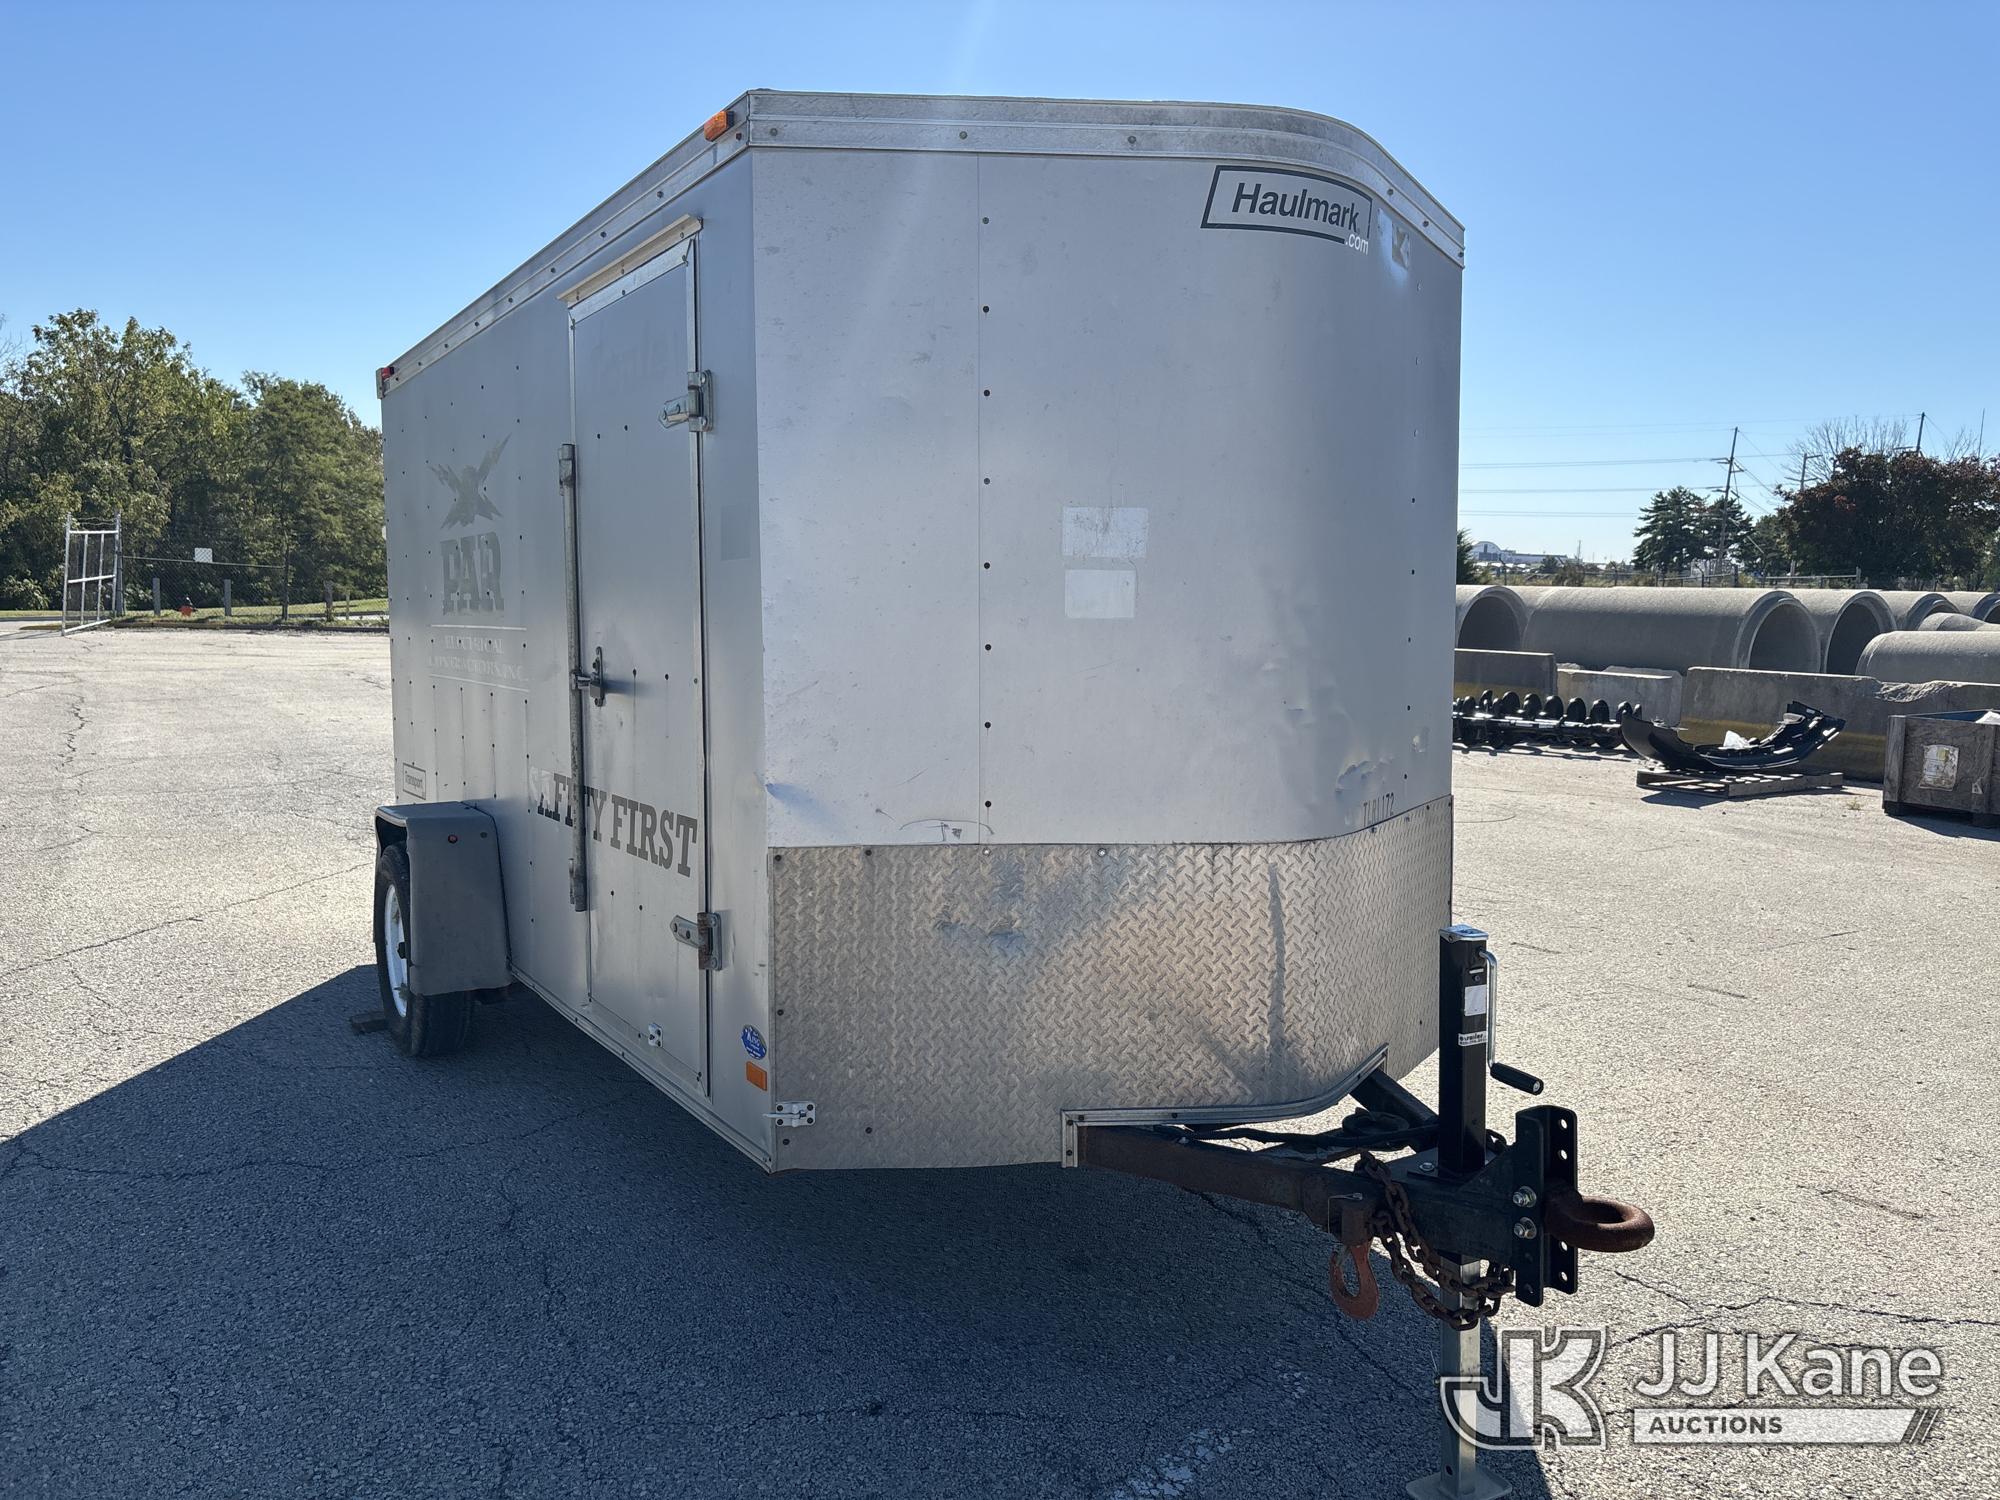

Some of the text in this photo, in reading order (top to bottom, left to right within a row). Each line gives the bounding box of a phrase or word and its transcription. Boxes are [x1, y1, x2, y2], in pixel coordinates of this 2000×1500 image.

[1231, 182, 1360, 233] Haulmark
[1345, 232, 1369, 255] .com
[440, 532, 504, 616] PAR
[610, 793, 698, 877] FIRST
